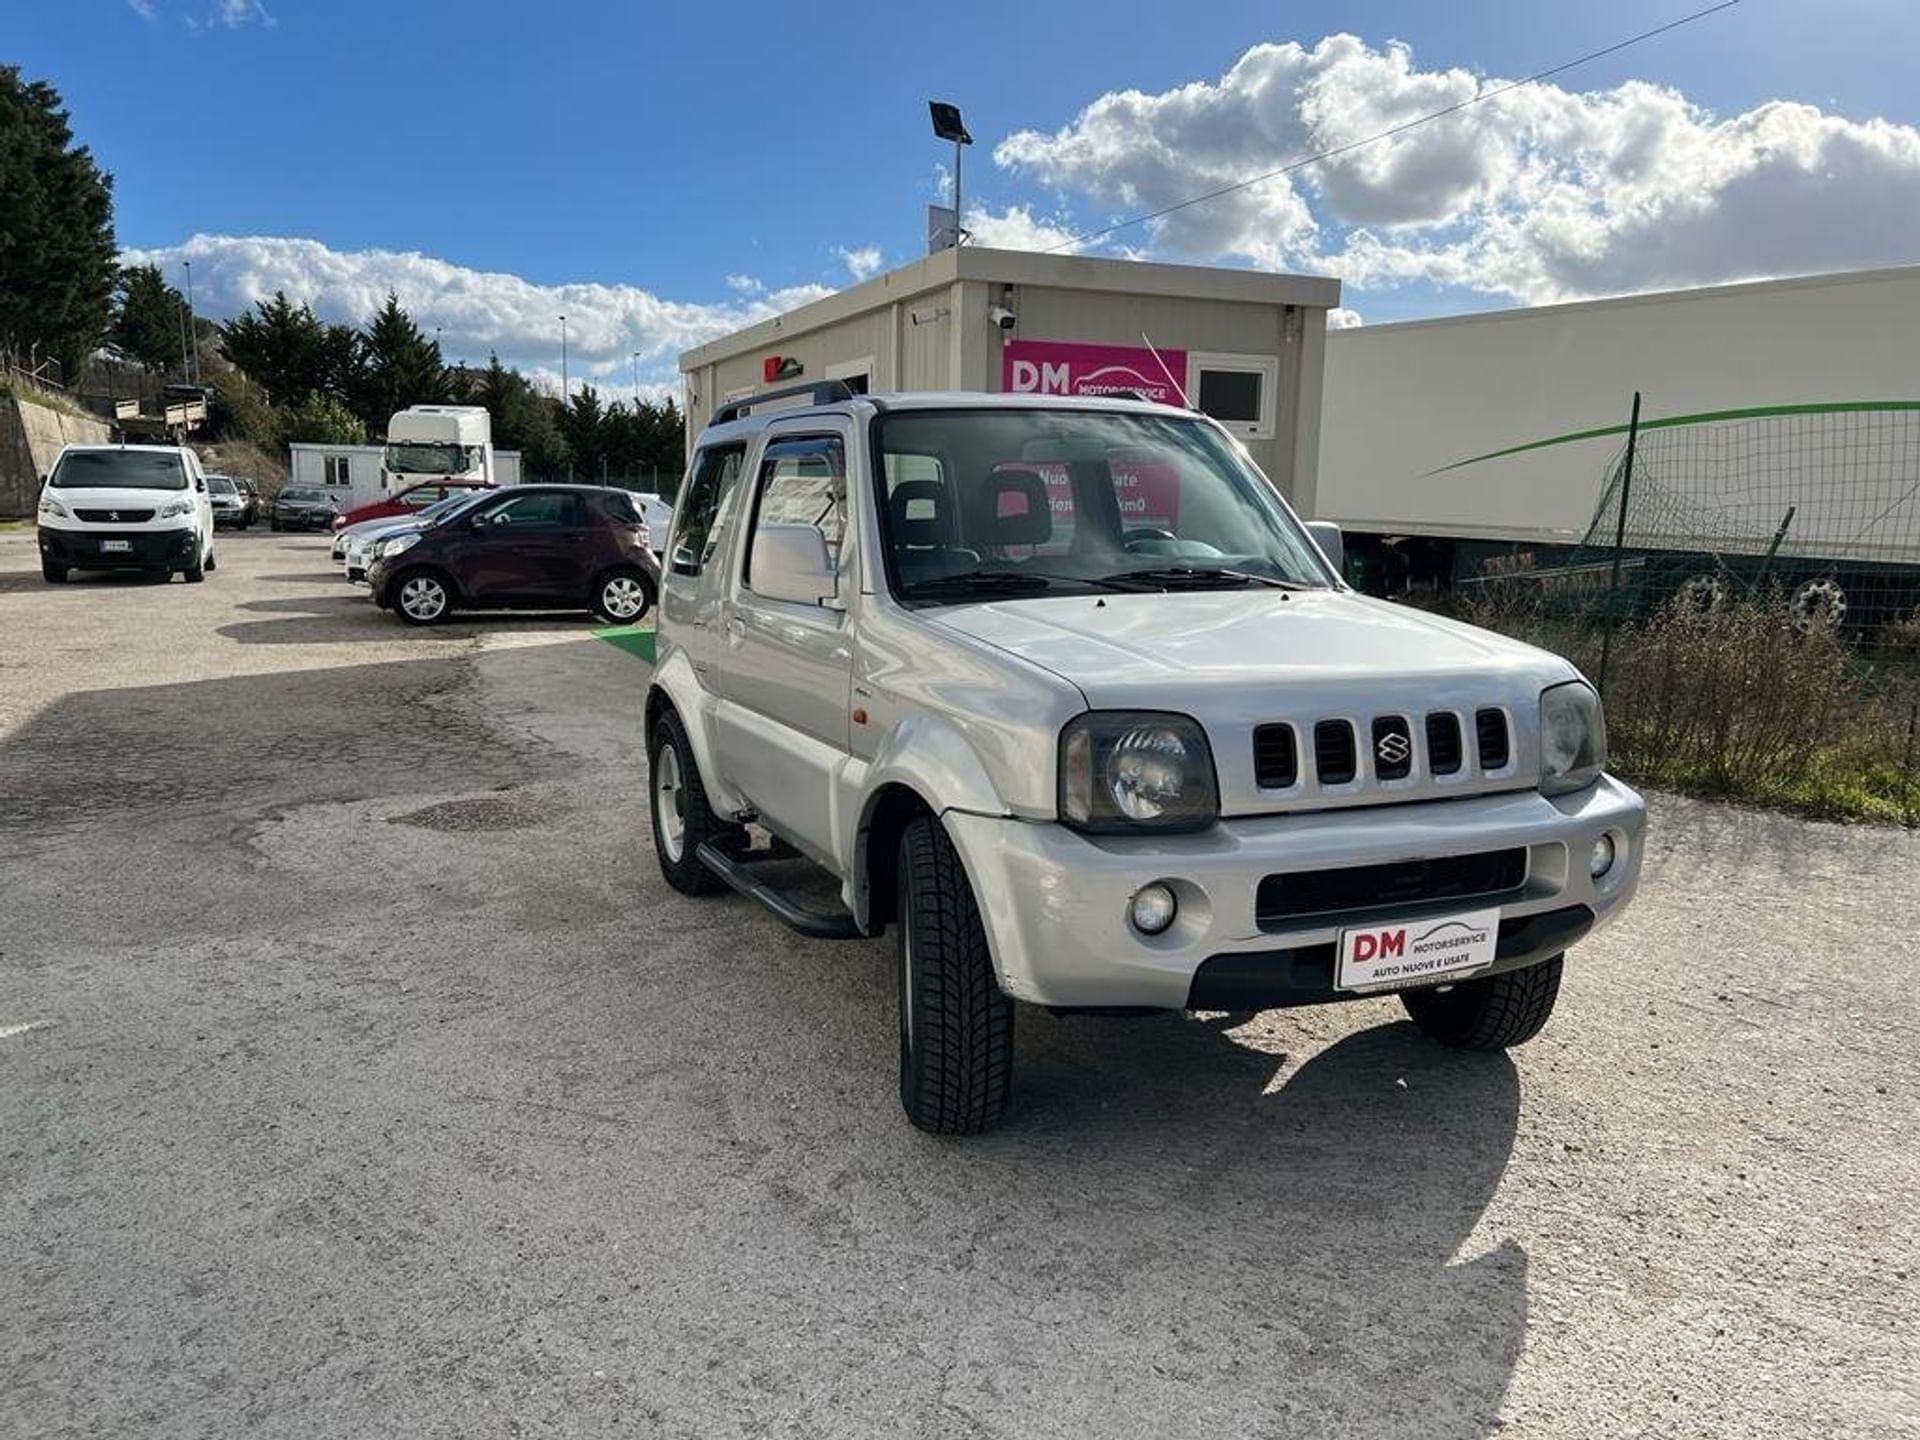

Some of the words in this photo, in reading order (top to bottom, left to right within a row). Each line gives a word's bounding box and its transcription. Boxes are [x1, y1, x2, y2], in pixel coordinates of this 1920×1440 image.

[1012, 360, 1070, 395] DM
[1353, 929, 1406, 963] DM
[1413, 932, 1487, 955] MOTORSERVICE
[1372, 965, 1400, 978] AUTO
[1402, 960, 1435, 975] NUOVE
[1436, 957, 1442, 967] E
[1443, 953, 1471, 966] USATE
